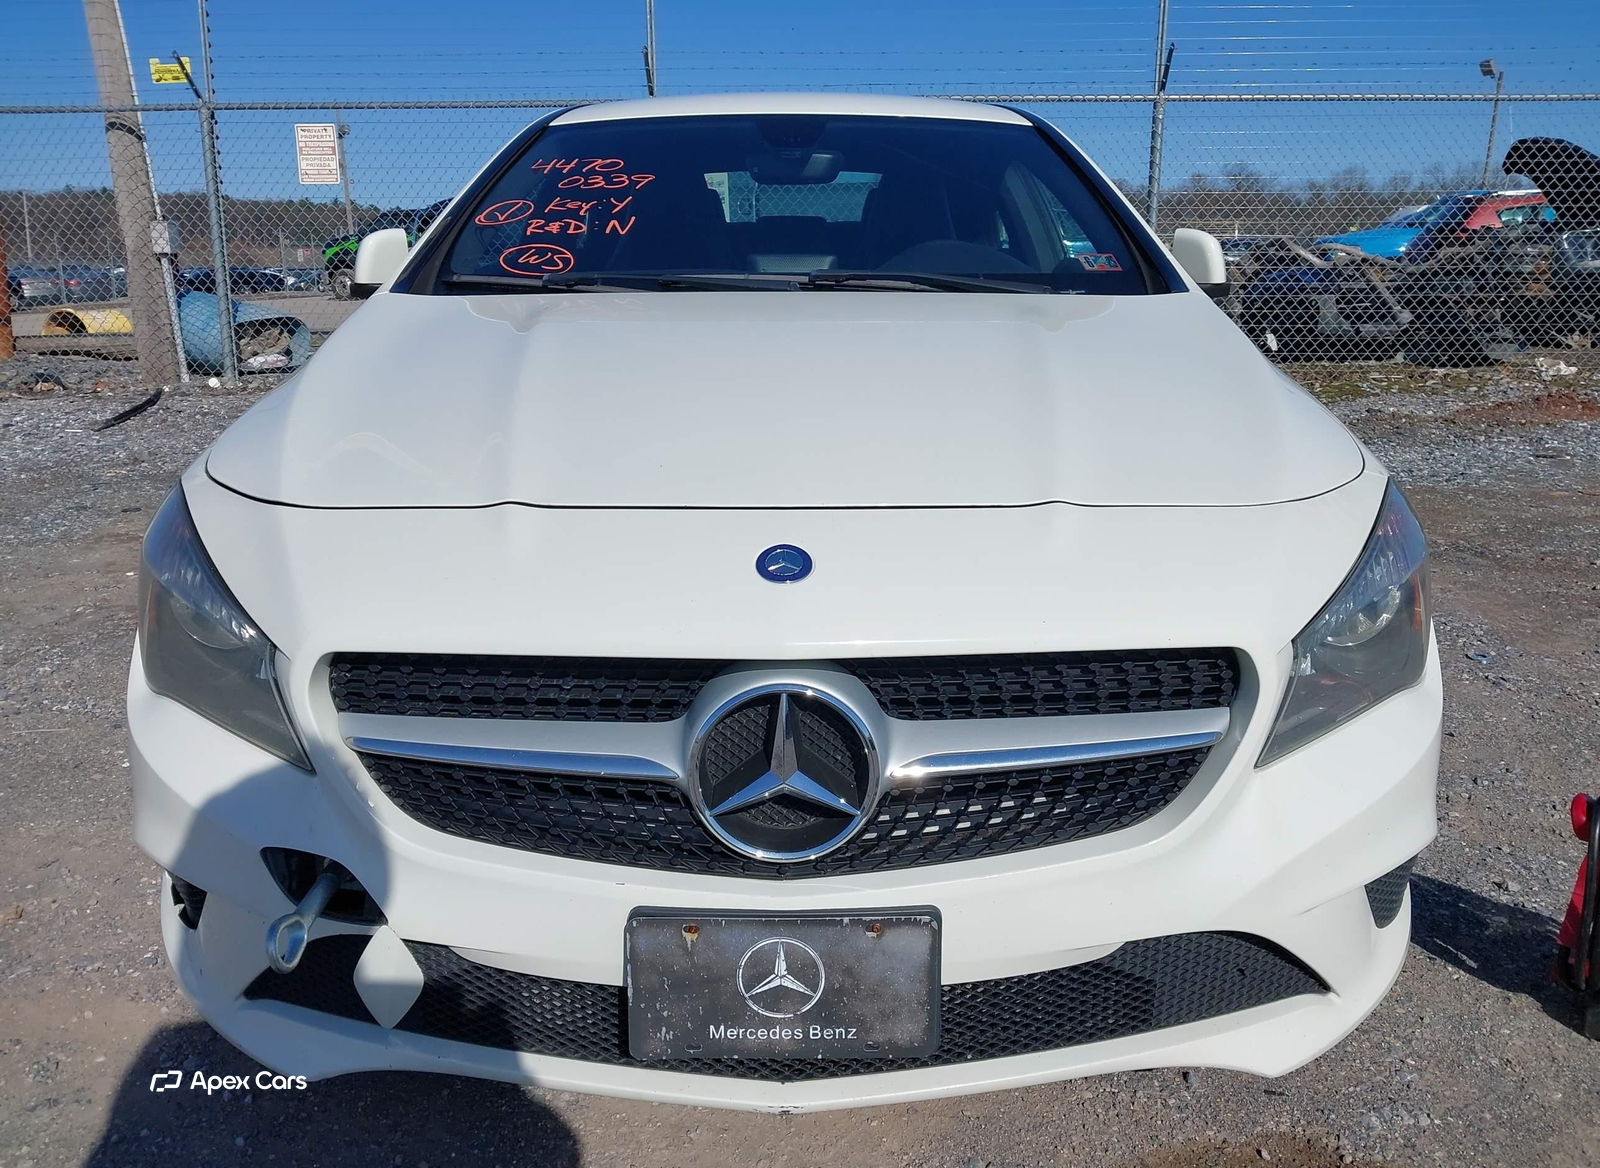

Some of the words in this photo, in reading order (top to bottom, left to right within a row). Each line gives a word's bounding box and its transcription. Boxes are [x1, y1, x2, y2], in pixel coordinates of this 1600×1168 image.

[531, 158, 625, 174] 4470
[557, 173, 656, 190] 0339
[517, 248, 571, 271] WS
[709, 1025, 803, 1040] Mercedes
[809, 1025, 858, 1040] Benz
